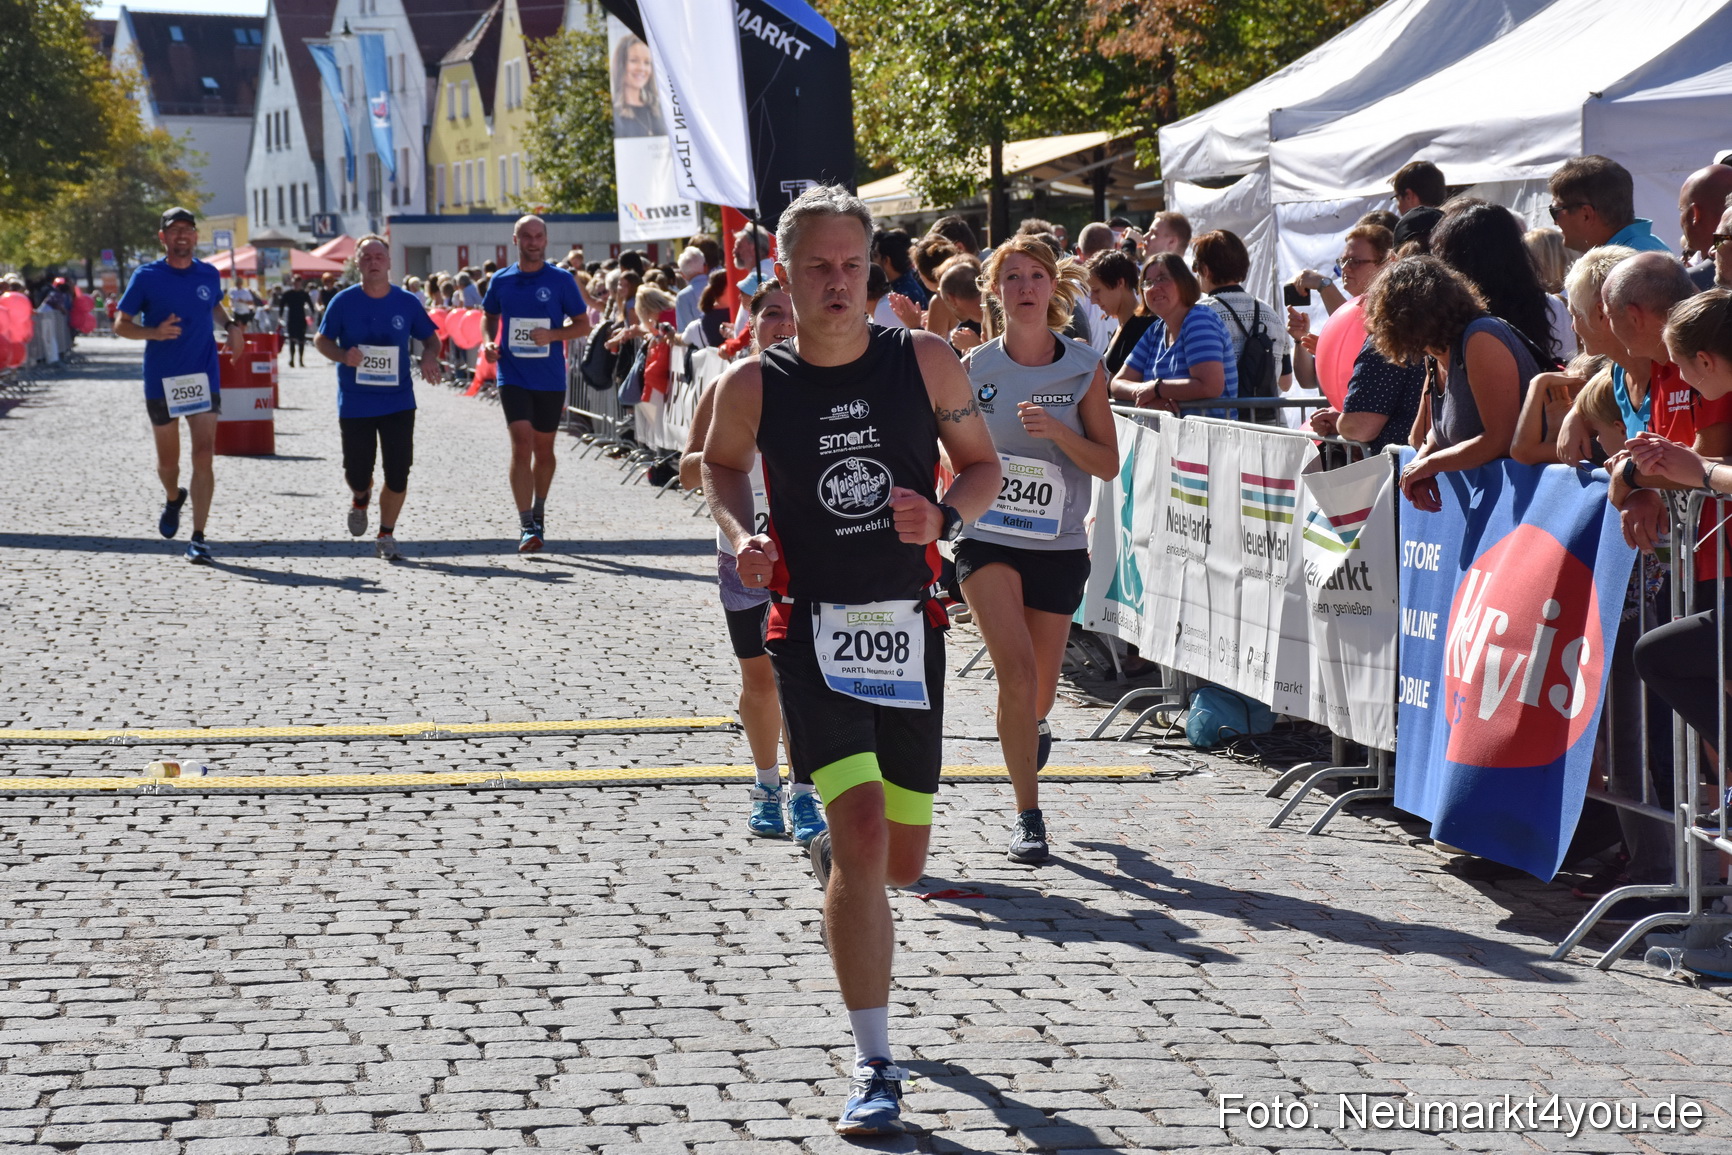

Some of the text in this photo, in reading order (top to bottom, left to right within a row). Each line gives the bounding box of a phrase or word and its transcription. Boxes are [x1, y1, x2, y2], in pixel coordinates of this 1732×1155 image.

[363, 355, 392, 370] 2591
[171, 384, 204, 401] 2592
[1032, 394, 1074, 404] BOCK
[831, 403, 849, 413] ebf
[819, 425, 878, 451] smart
[1008, 463, 1044, 476] BOCK
[847, 472, 887, 506] Weisse
[997, 476, 1053, 507] 2340
[1013, 506, 1039, 515] Neumarkt
[834, 518, 891, 537] www.ebf.li
[1002, 515, 1034, 529] Katrin
[1403, 539, 1442, 572] STORE
[846, 611, 895, 623] BOCK
[1332, 601, 1373, 617] genießen
[832, 629, 910, 664] 2098
[1445, 567, 1591, 721] Hervis
[841, 666, 895, 676] PARTL Neumarkt
[853, 681, 896, 697] Ronald
[1273, 680, 1304, 696] markt
